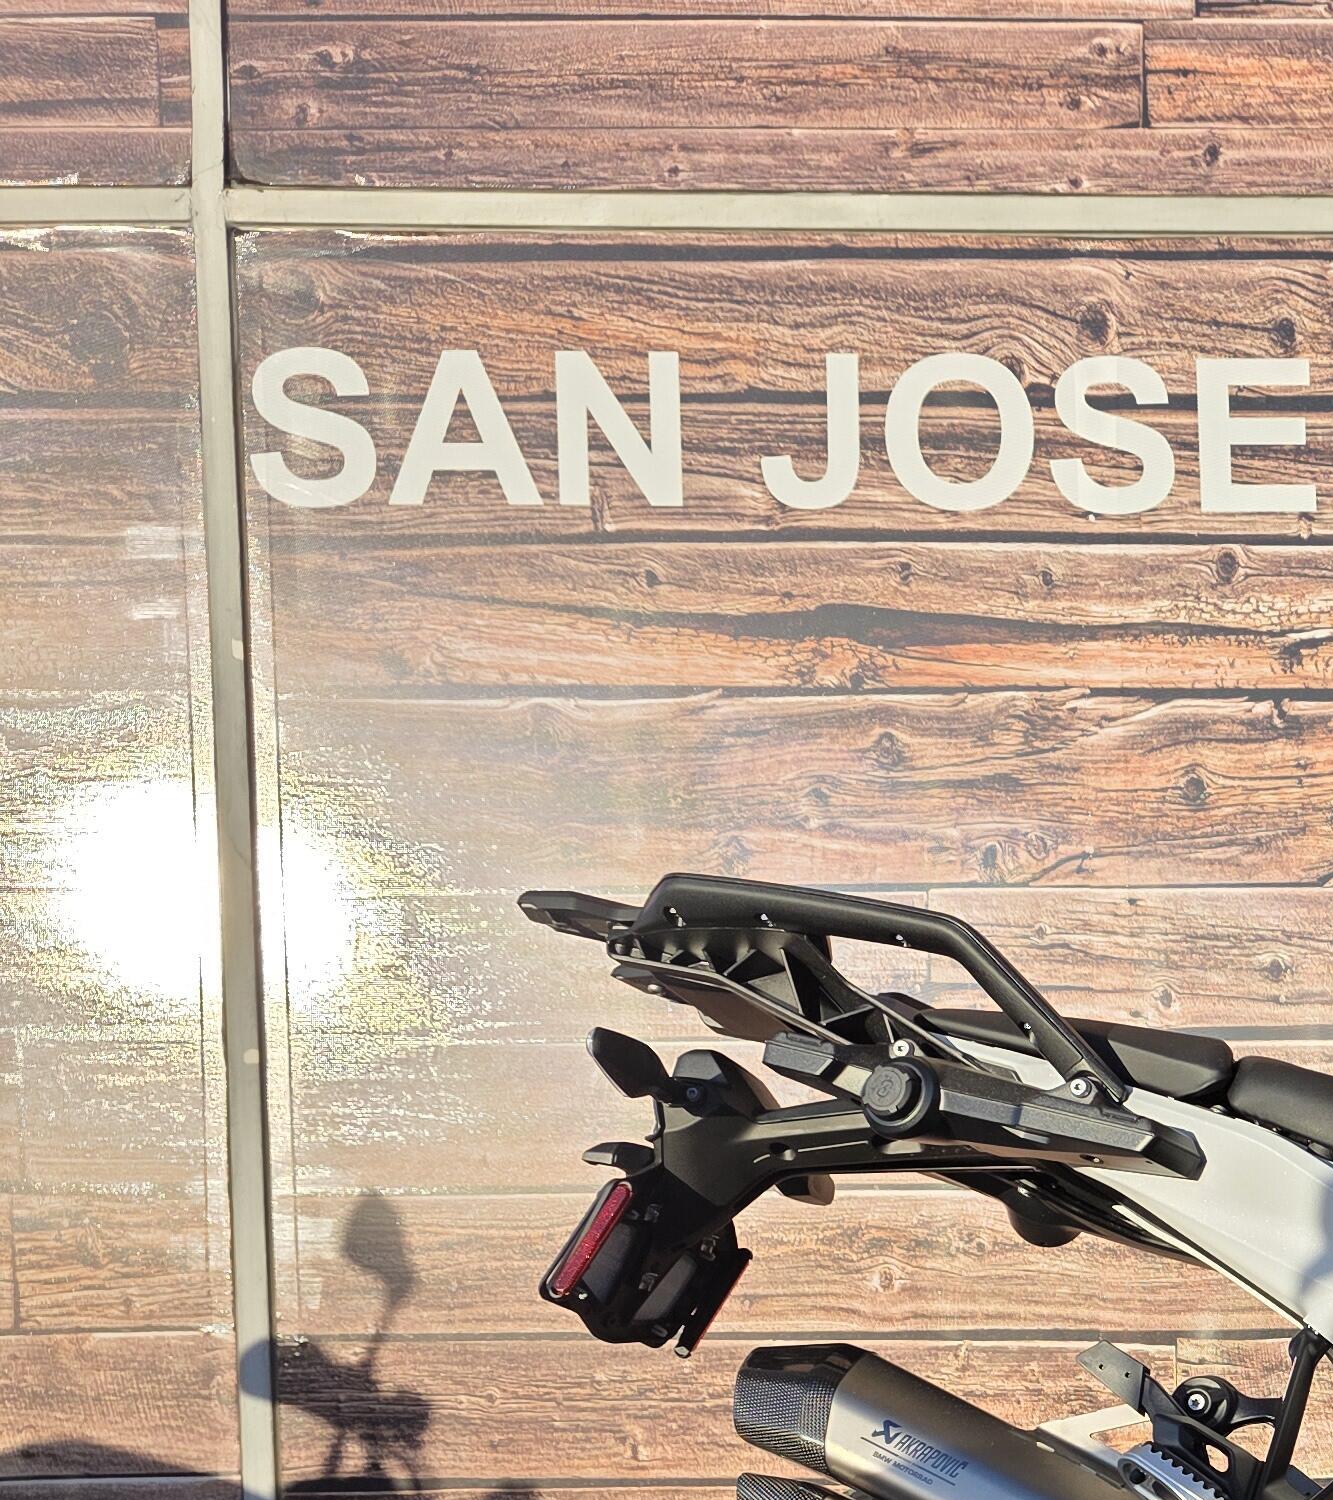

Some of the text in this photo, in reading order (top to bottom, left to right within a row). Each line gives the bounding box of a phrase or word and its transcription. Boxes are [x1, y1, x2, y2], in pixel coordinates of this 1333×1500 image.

[249, 346, 683, 509] SAN
[760, 351, 1317, 513] JOSE
[872, 1451, 934, 1485] BMW MOTORRAD
